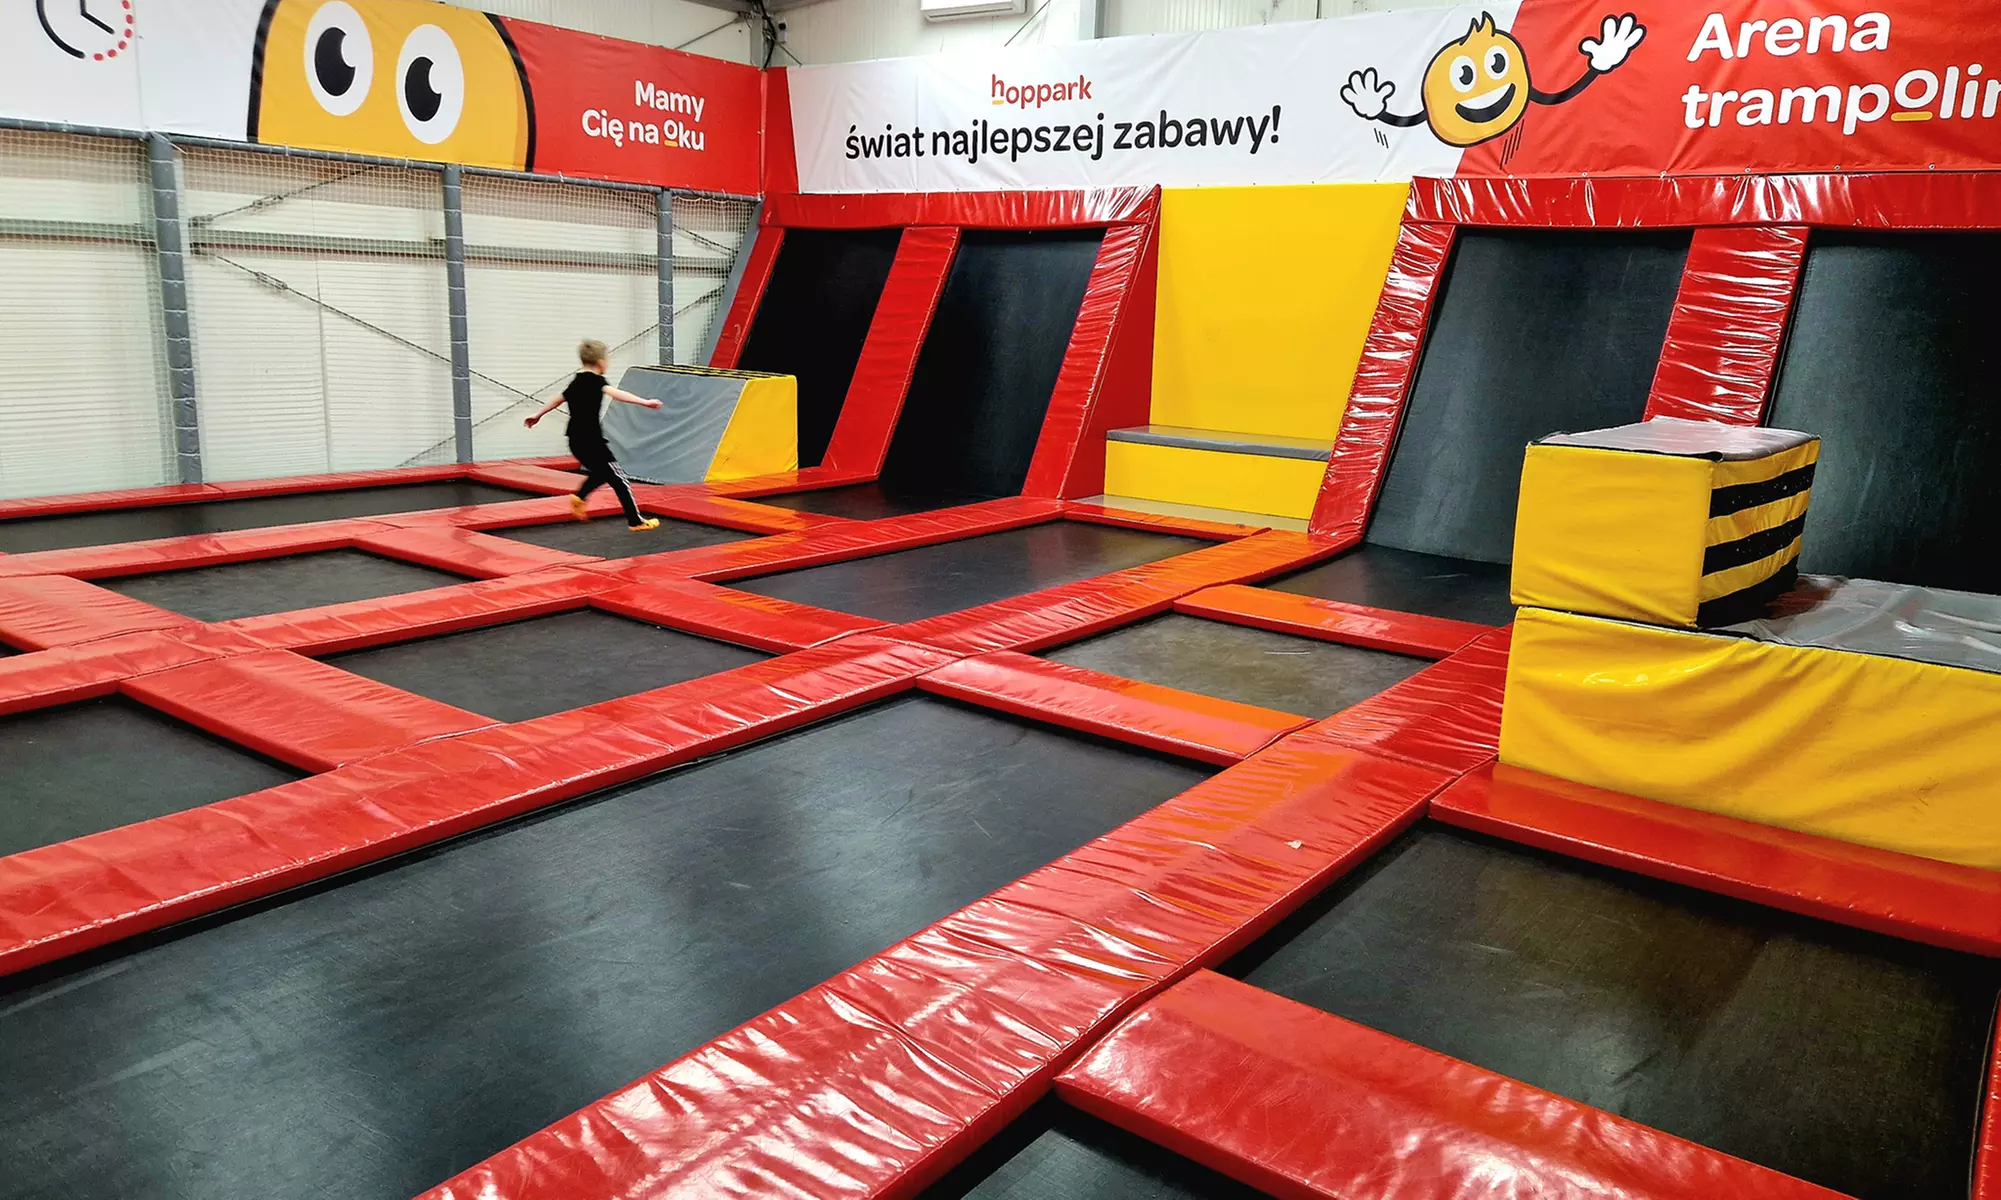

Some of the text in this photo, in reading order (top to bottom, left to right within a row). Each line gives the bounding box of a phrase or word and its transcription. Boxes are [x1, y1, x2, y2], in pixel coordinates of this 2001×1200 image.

[1686, 11, 1891, 62] Arena
[635, 80, 705, 123] Mamy
[991, 74, 1092, 109] hoppark
[581, 109, 705, 151] Cię na oku
[845, 105, 1282, 164] świat najlepszej zabawy!
